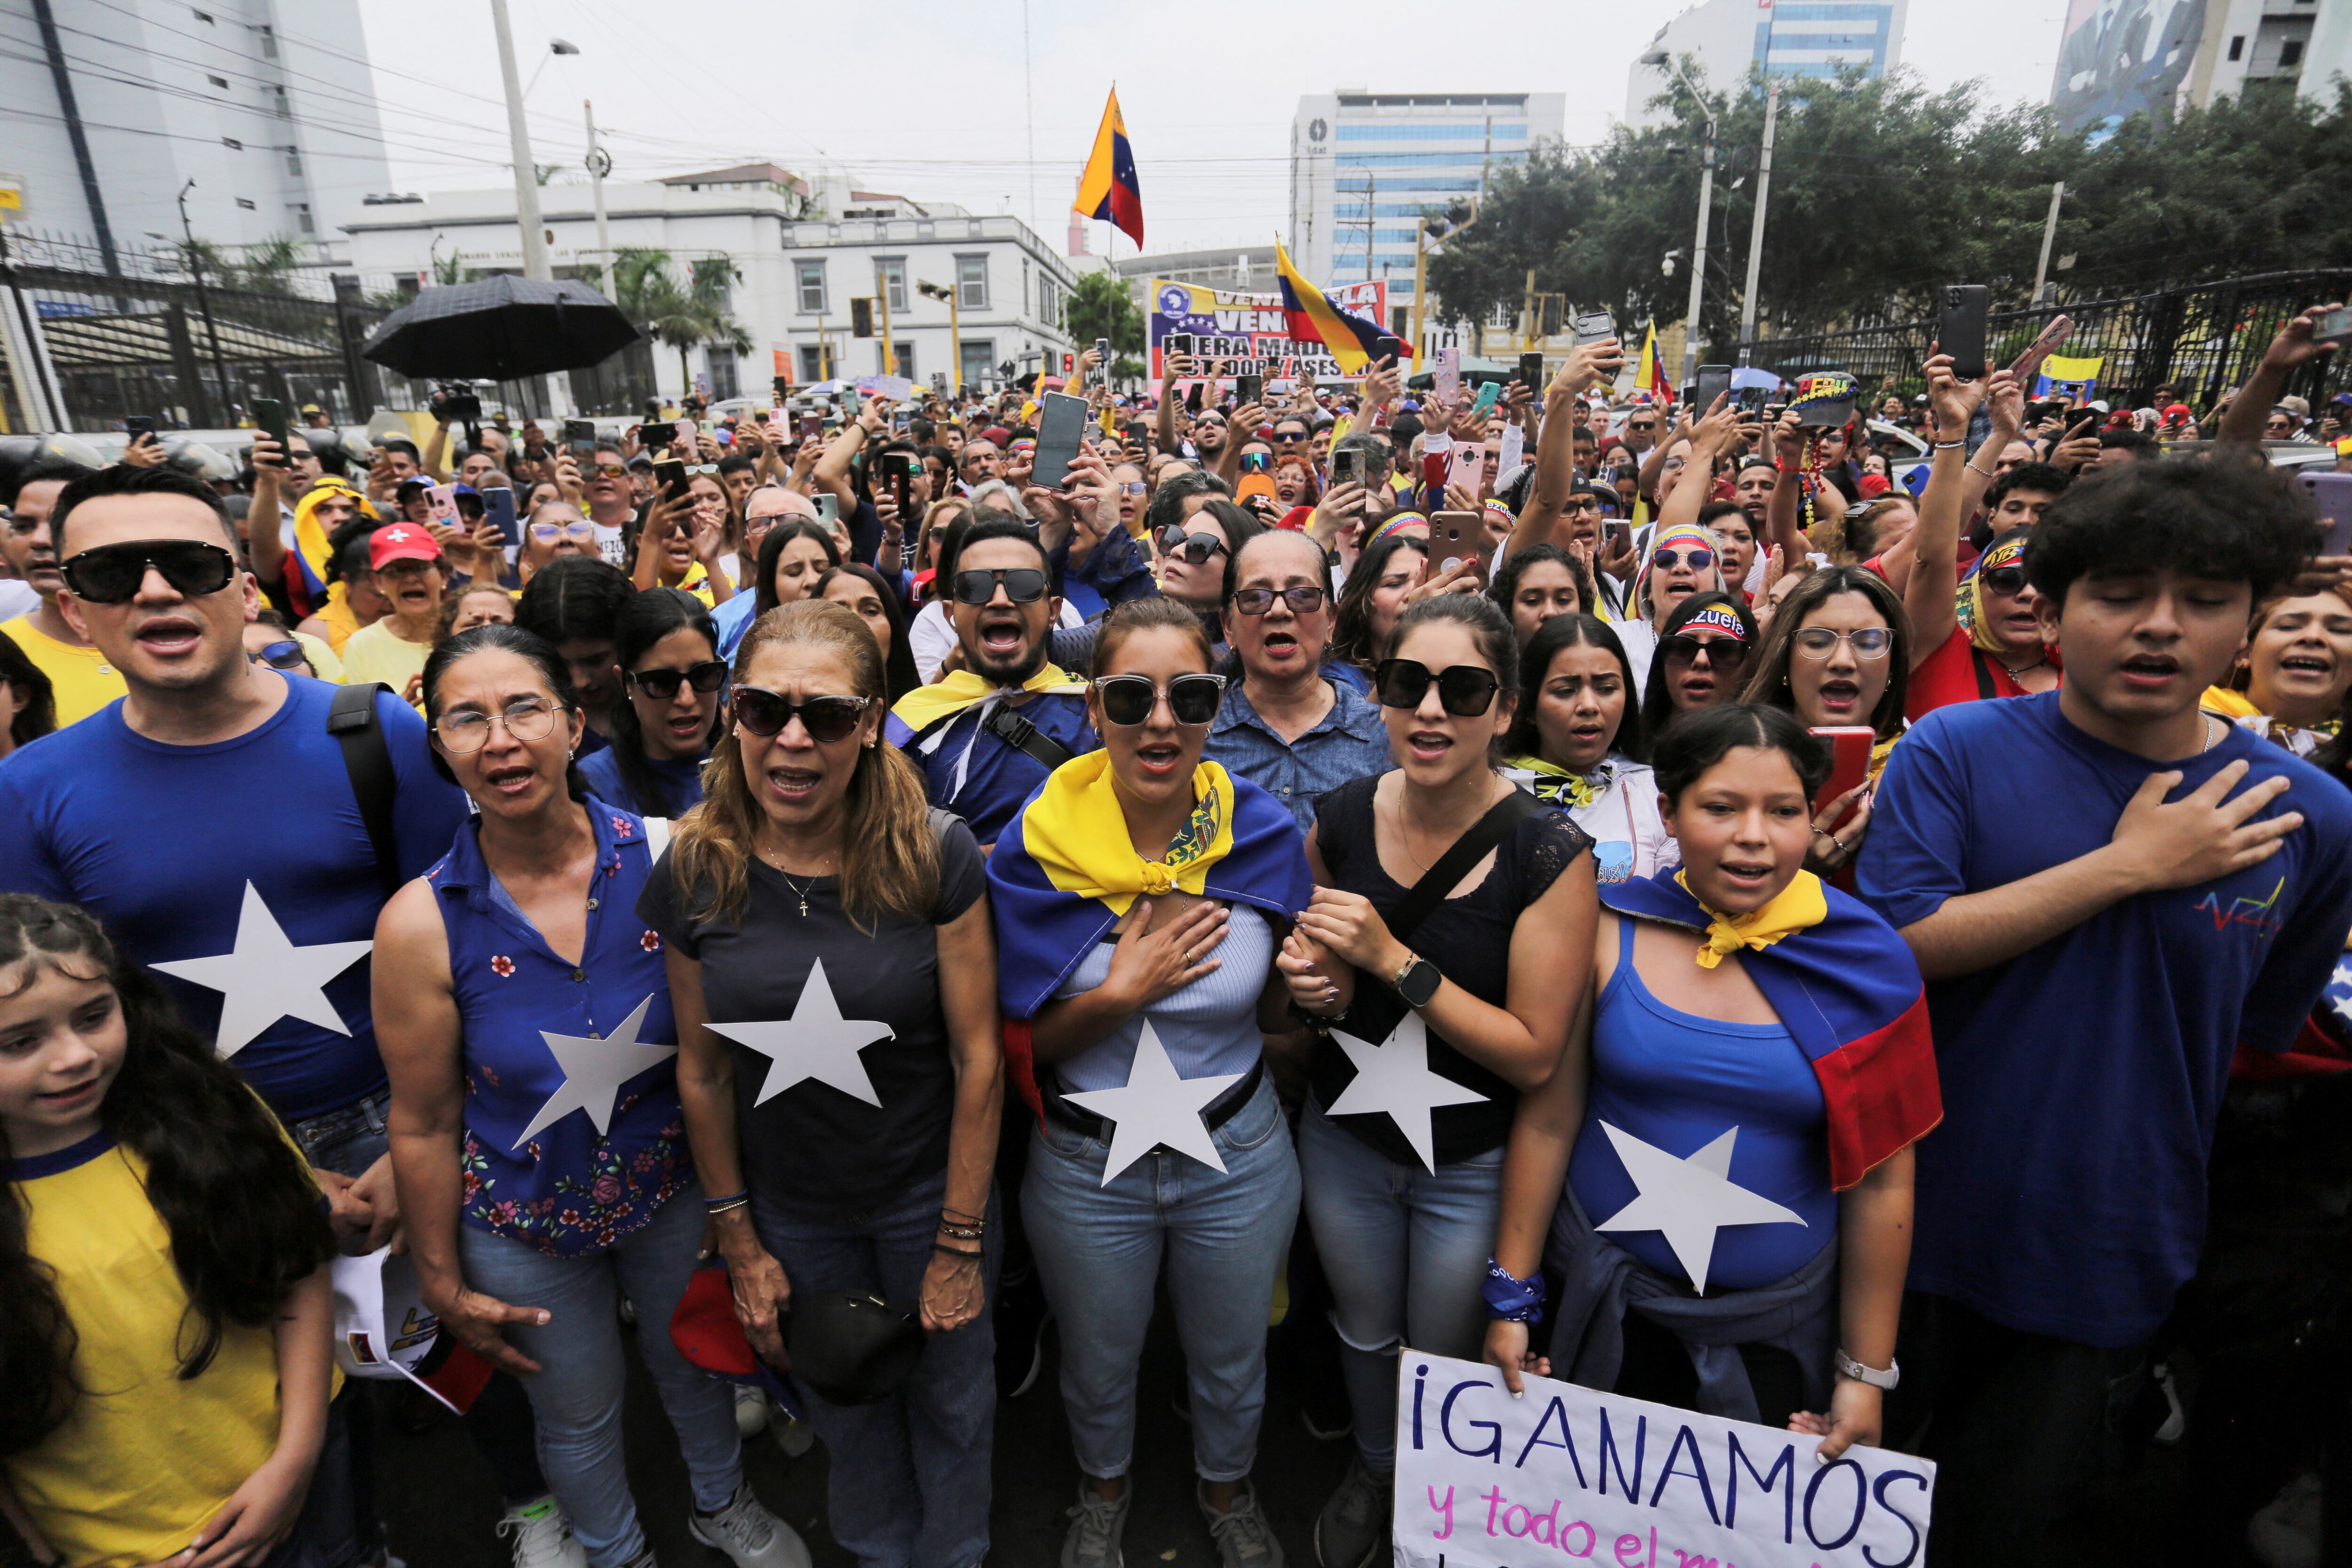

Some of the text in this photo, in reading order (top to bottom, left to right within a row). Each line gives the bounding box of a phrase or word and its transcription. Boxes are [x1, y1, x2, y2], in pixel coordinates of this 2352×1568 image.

[1163, 335, 1252, 357] FERA
[1428, 1484, 1657, 1568] y todo el
